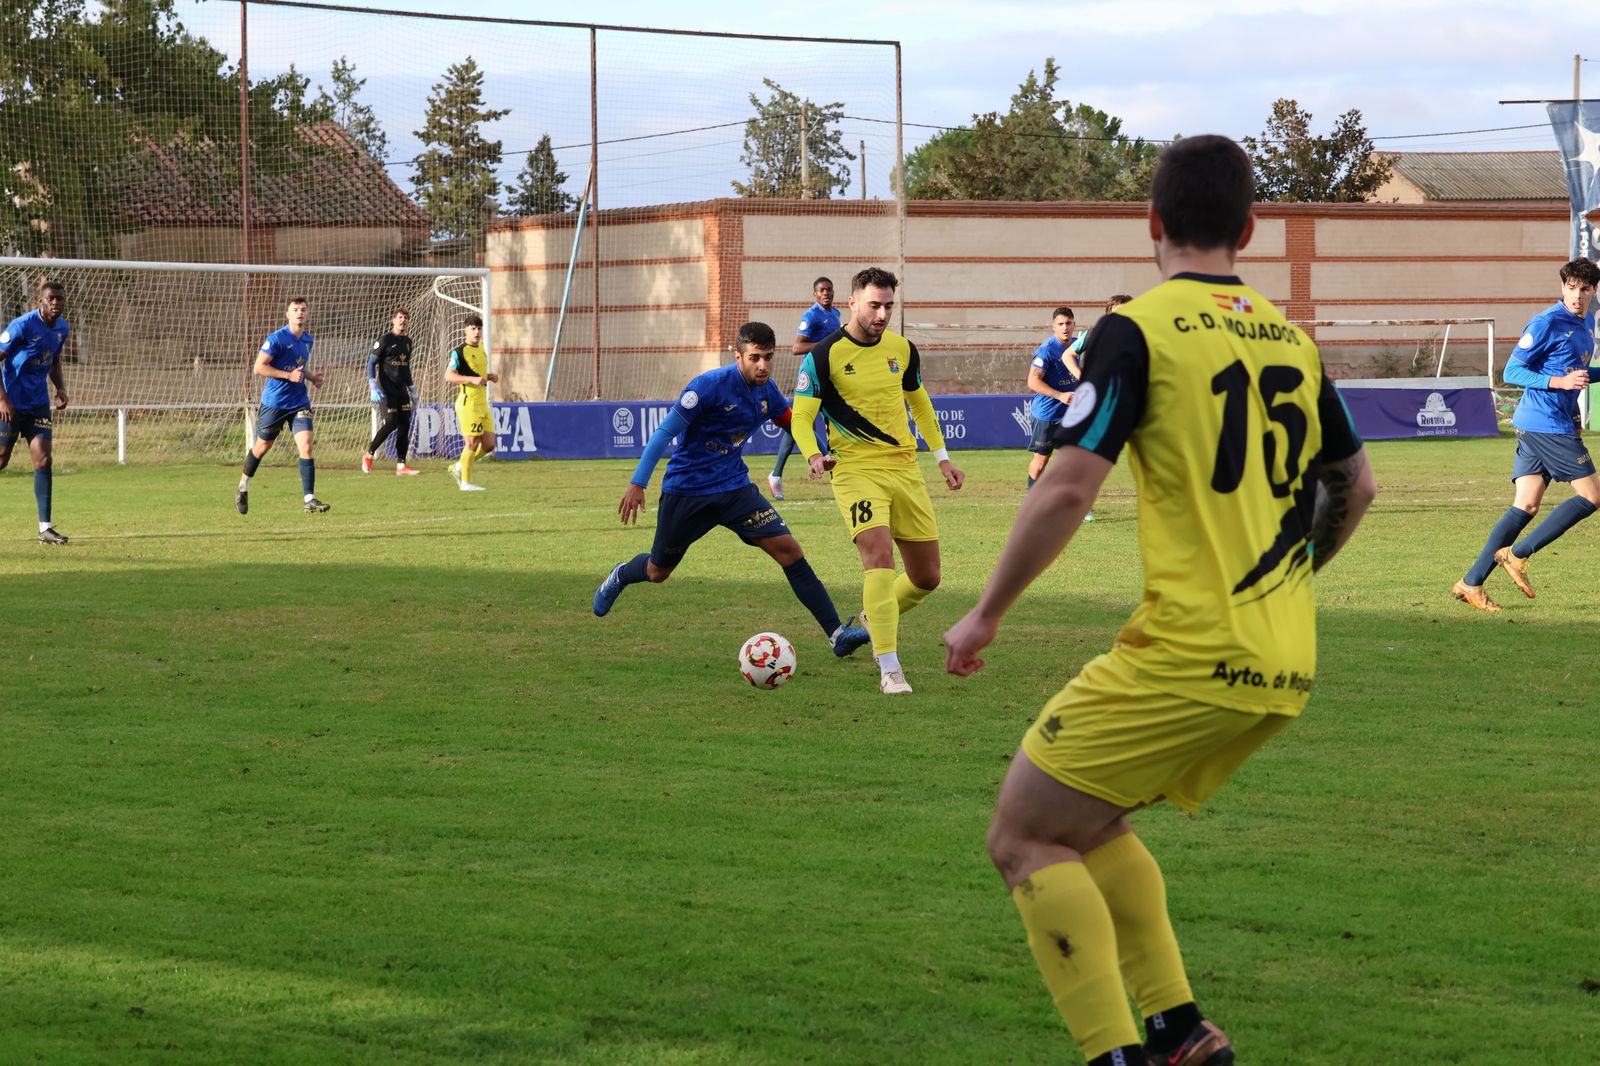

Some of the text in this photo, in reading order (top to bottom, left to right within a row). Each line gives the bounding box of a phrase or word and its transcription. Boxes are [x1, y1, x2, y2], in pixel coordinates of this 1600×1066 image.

[1222, 315, 1302, 347] MOJADOS
[470, 422, 484, 434] 26
[951, 410, 965, 421] DE
[1210, 358, 1308, 499] 15
[850, 499, 873, 528] 18
[1211, 660, 1268, 688] Ayto.
